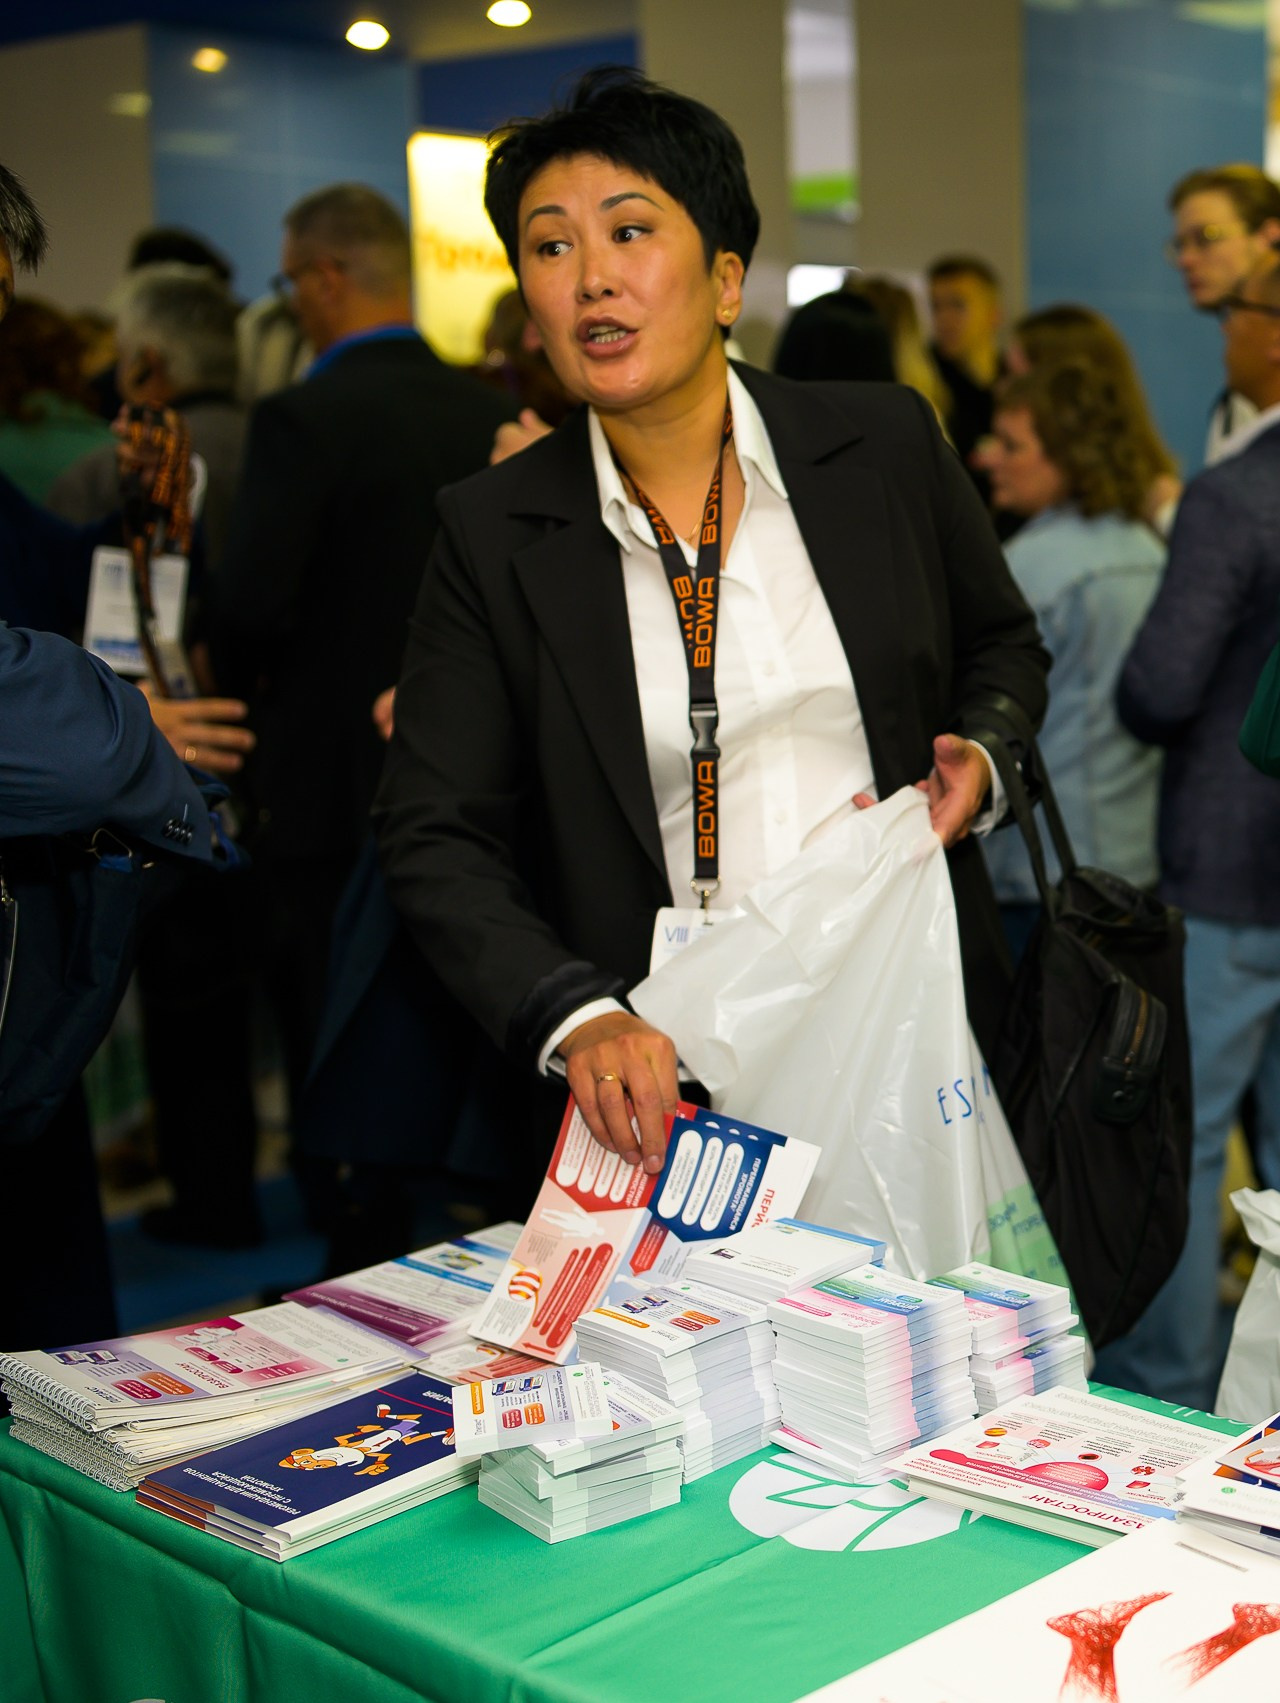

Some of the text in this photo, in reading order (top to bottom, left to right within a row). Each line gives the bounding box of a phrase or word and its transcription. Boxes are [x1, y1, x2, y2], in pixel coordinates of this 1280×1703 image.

[637, 489, 675, 545] OWA
[701, 473, 720, 545] BOW
[693, 577, 715, 668] BOWA
[698, 760, 715, 858] BOWA
[729, 1158, 762, 1231] ПЕРЕМЕЖАЮЩАЯСЯ
[182, 1467, 302, 1515] РЕКОМЕНДАЦИИ ДЛЯ ПАЦИЕНТОВ
[211, 1470, 286, 1501] ПЕРЕМЕЖАЮЩЕЙСЯ
[240, 1474, 284, 1492] ХРОМОТОЙ
